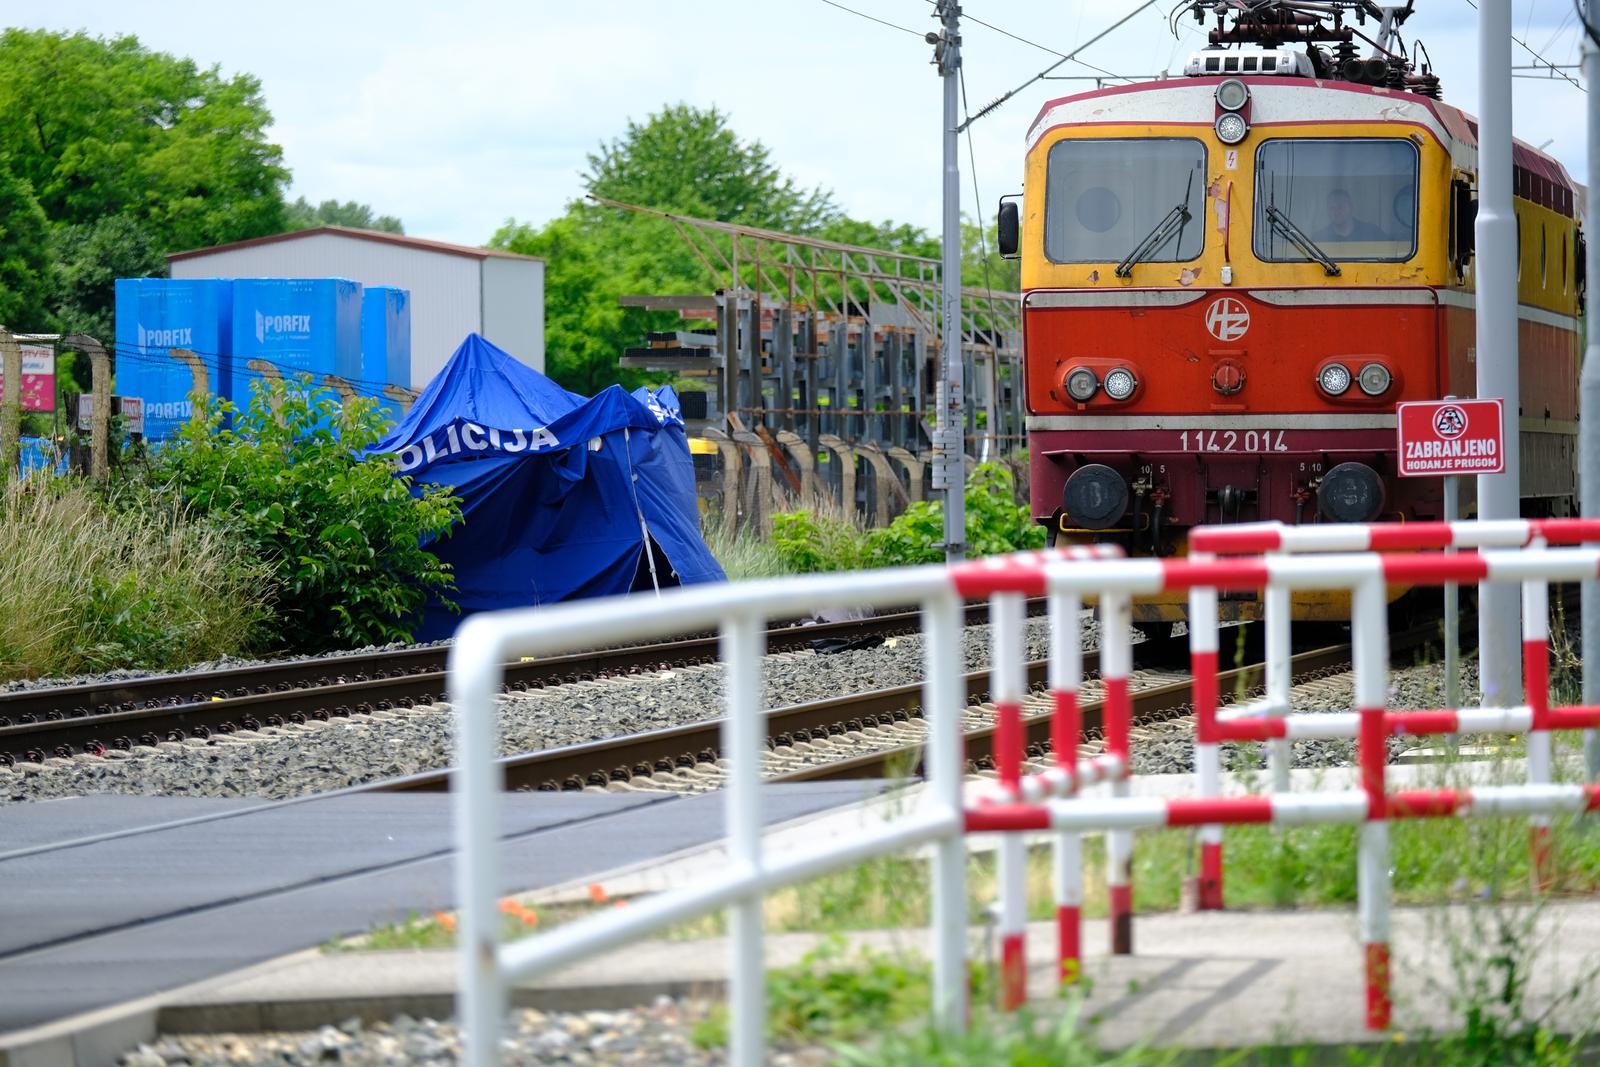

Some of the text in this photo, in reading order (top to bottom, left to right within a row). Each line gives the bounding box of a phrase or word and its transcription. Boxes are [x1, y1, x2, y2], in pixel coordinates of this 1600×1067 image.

[265, 315, 311, 333] PORFIX
[147, 328, 192, 346] PORFIX
[146, 401, 192, 418] PORFIX
[390, 422, 560, 473] OLICIJA
[1244, 430, 1288, 451] 014
[1406, 439, 1496, 459] ZABRANJENO
[1160, 464, 1166, 473] 5
[1300, 463, 1322, 472] 5 10
[1406, 458, 1497, 470] HODANJE PRUGOM
